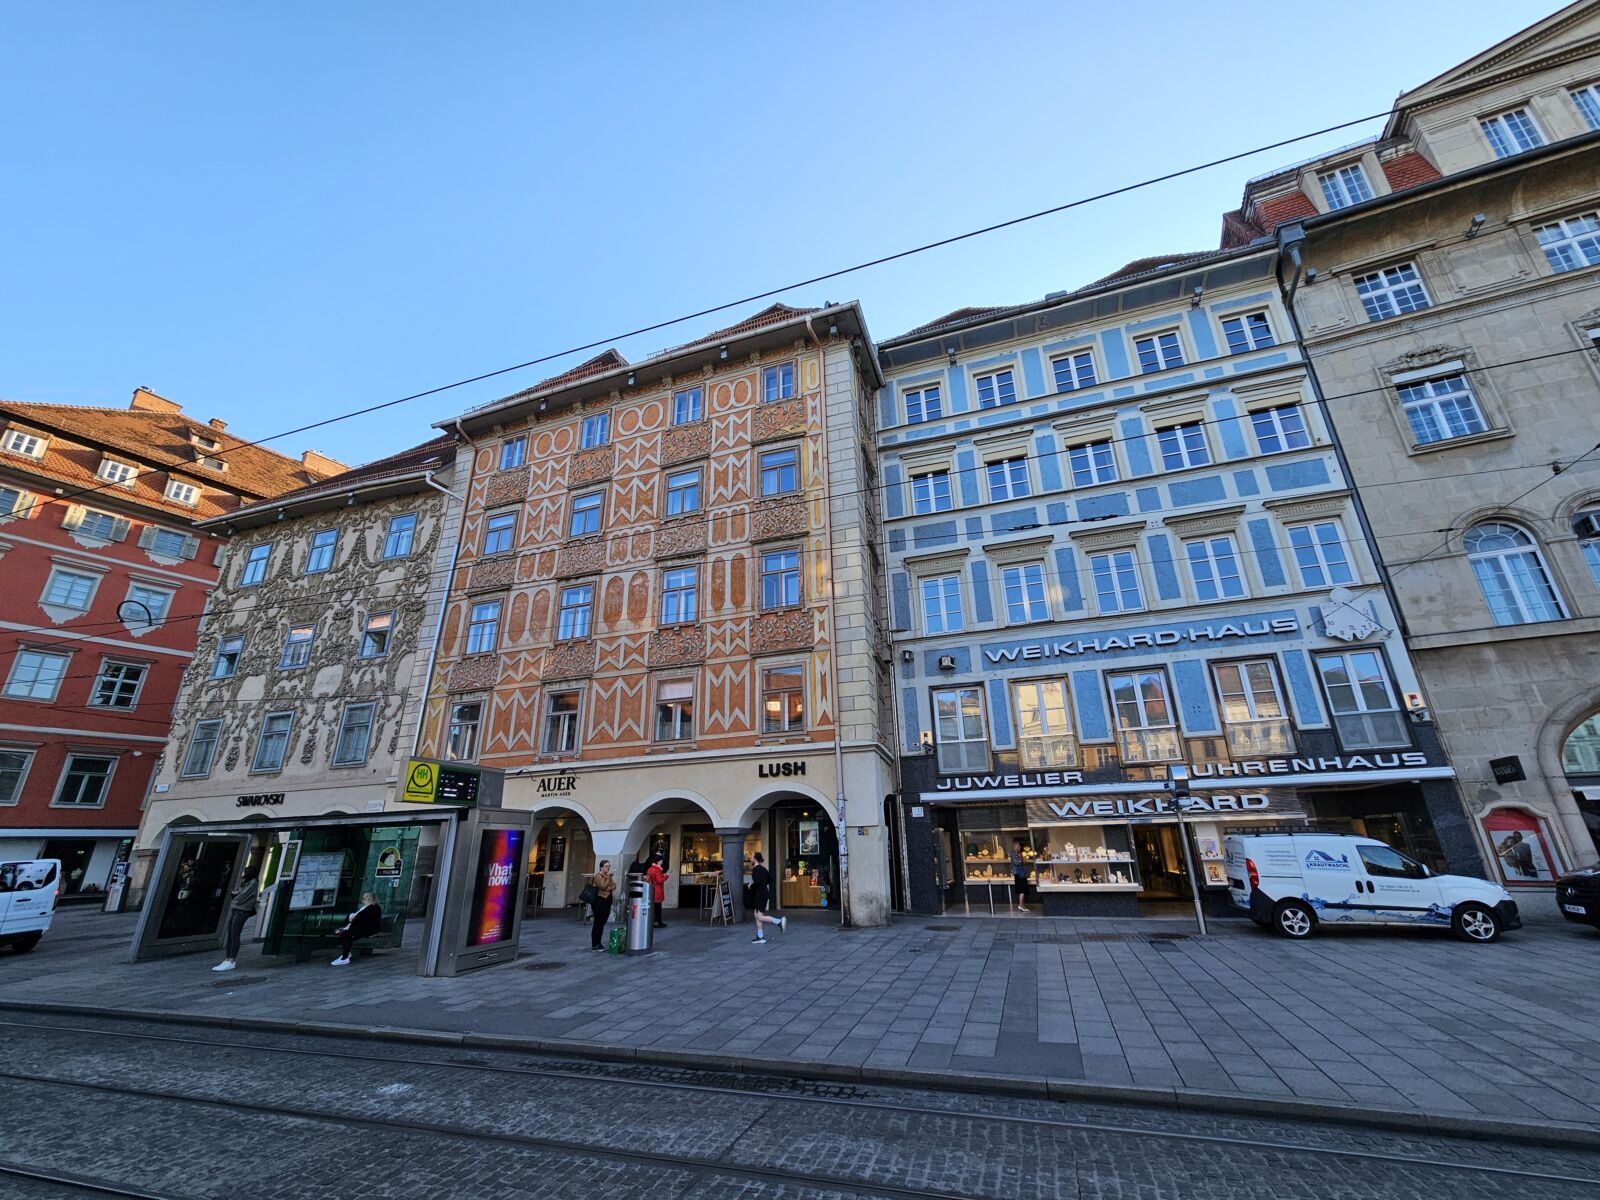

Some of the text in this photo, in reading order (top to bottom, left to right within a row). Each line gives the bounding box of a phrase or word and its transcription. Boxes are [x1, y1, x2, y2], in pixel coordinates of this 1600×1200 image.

[758, 761, 806, 778] LUSH
[936, 752, 1427, 790] JUWELIER UHRENHAUS
[536, 776, 576, 792] AUER
[235, 793, 285, 808] SWAROVSKI
